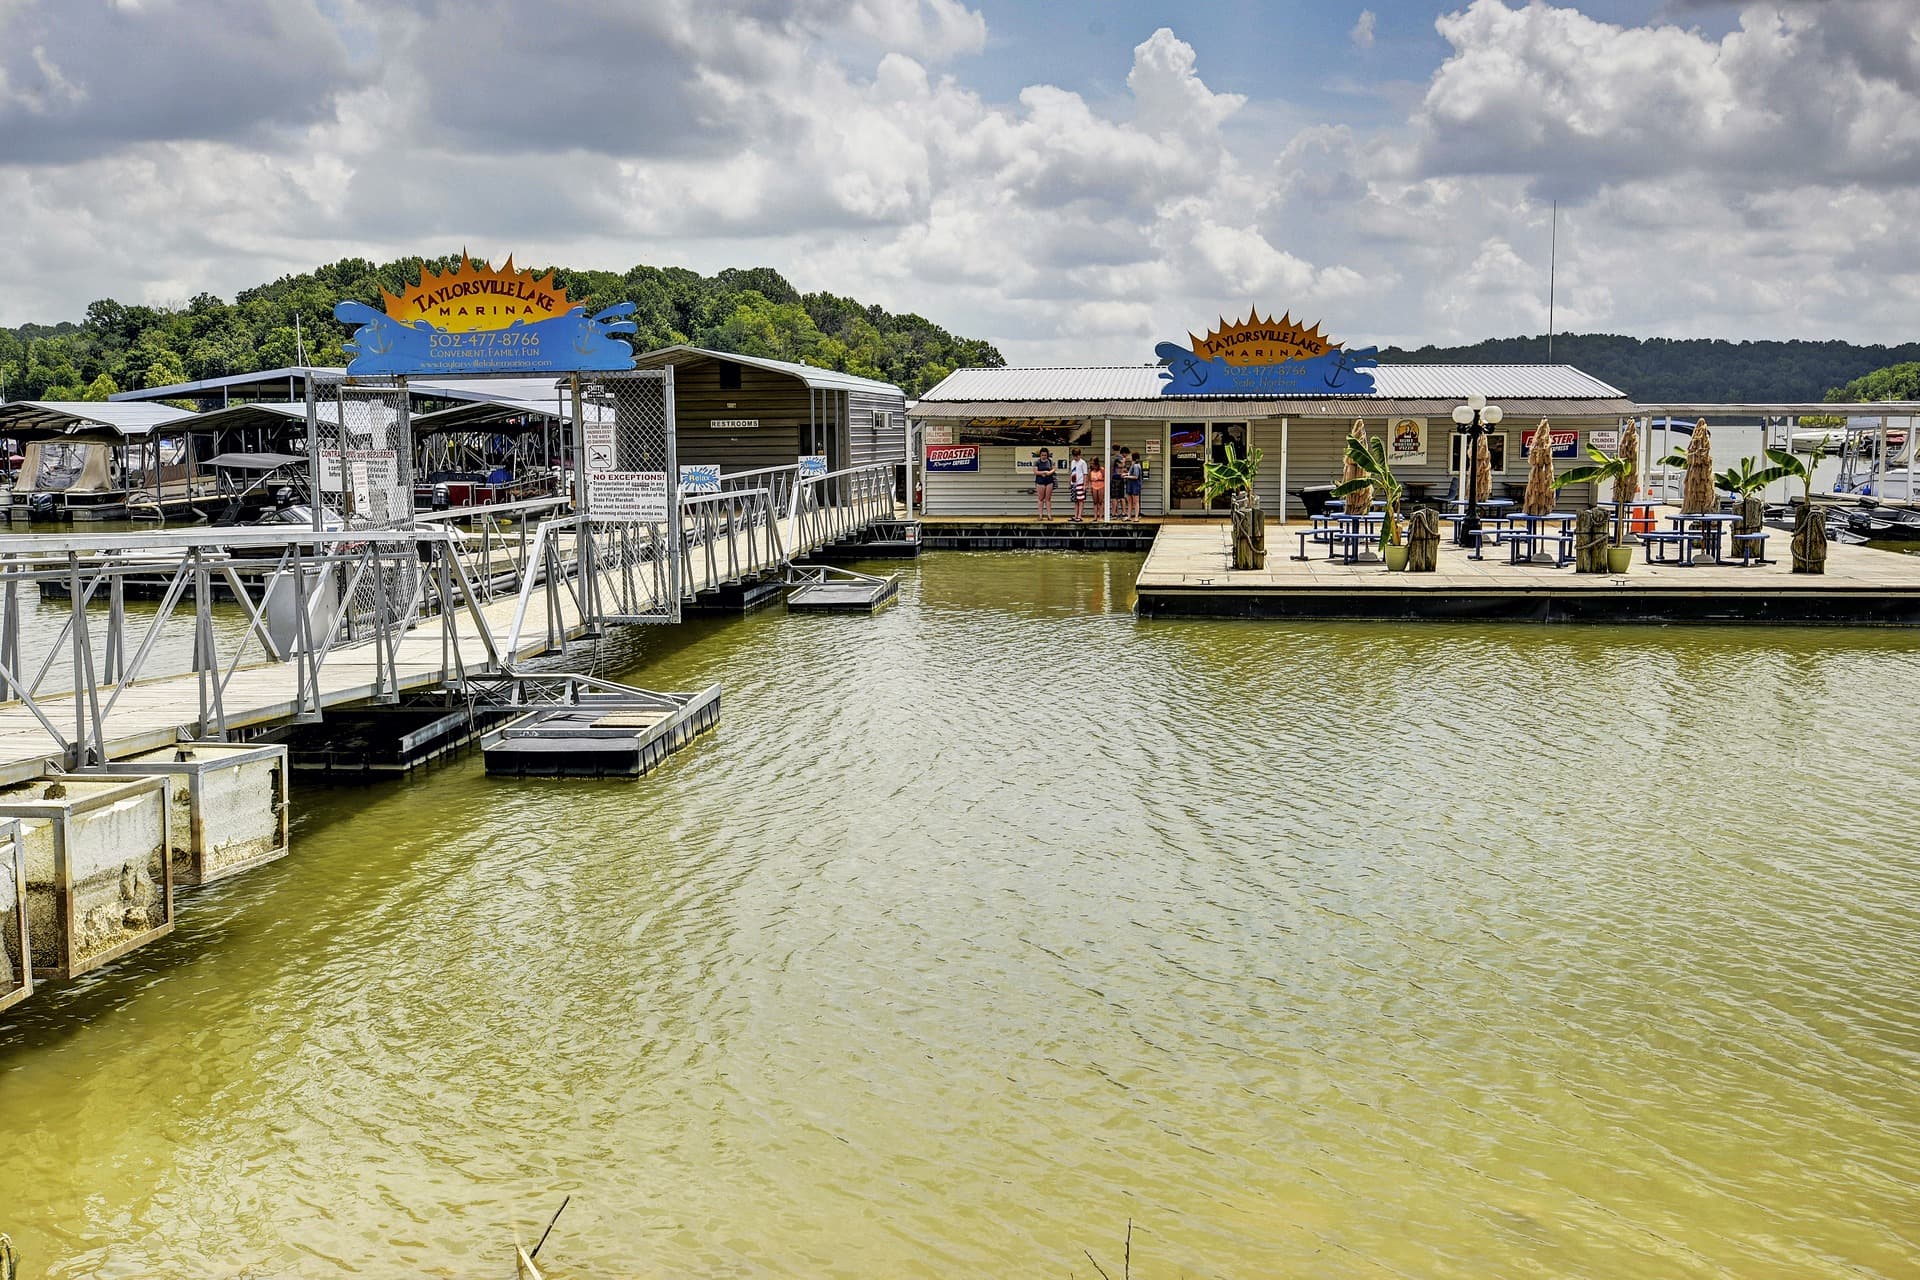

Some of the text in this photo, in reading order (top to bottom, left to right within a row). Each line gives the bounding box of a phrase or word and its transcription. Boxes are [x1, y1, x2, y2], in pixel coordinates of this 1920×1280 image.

[412, 279, 555, 314] TAYLORSVILLE LAKE
[439, 305, 534, 317] MARINA
[429, 333, 540, 348] 502-477-8766
[1203, 329, 1322, 355] TAYLORSVILLE LAKE
[522, 347, 540, 356] FUN
[1224, 349, 1304, 357] MARINA
[930, 448, 975, 462] BROASTER
